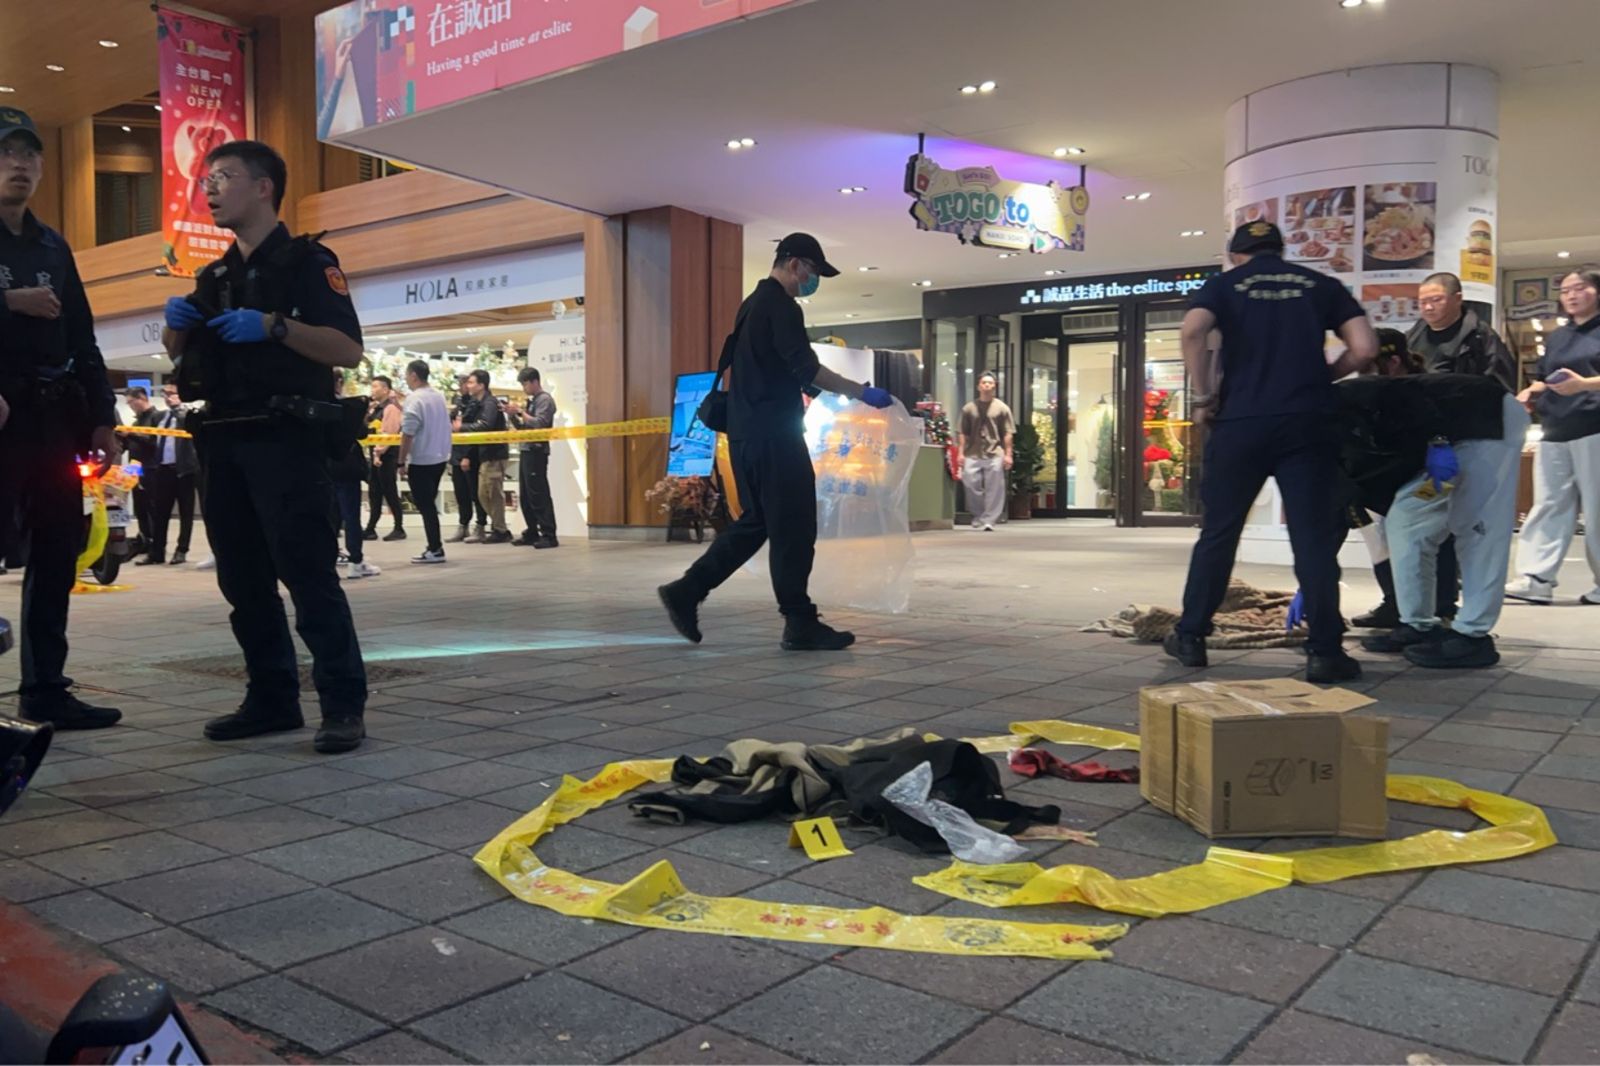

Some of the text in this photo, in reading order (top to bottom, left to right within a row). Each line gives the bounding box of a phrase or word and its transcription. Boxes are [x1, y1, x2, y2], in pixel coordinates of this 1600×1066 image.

[426, 21, 573, 76] Having a good time at eslite
[190, 84, 222, 98] NEW
[933, 191, 1030, 224] TOGO to
[405, 277, 459, 305] HOLA
[1105, 281, 1131, 298] the
[1132, 278, 1174, 295] eslite
[811, 823, 828, 847] 1
